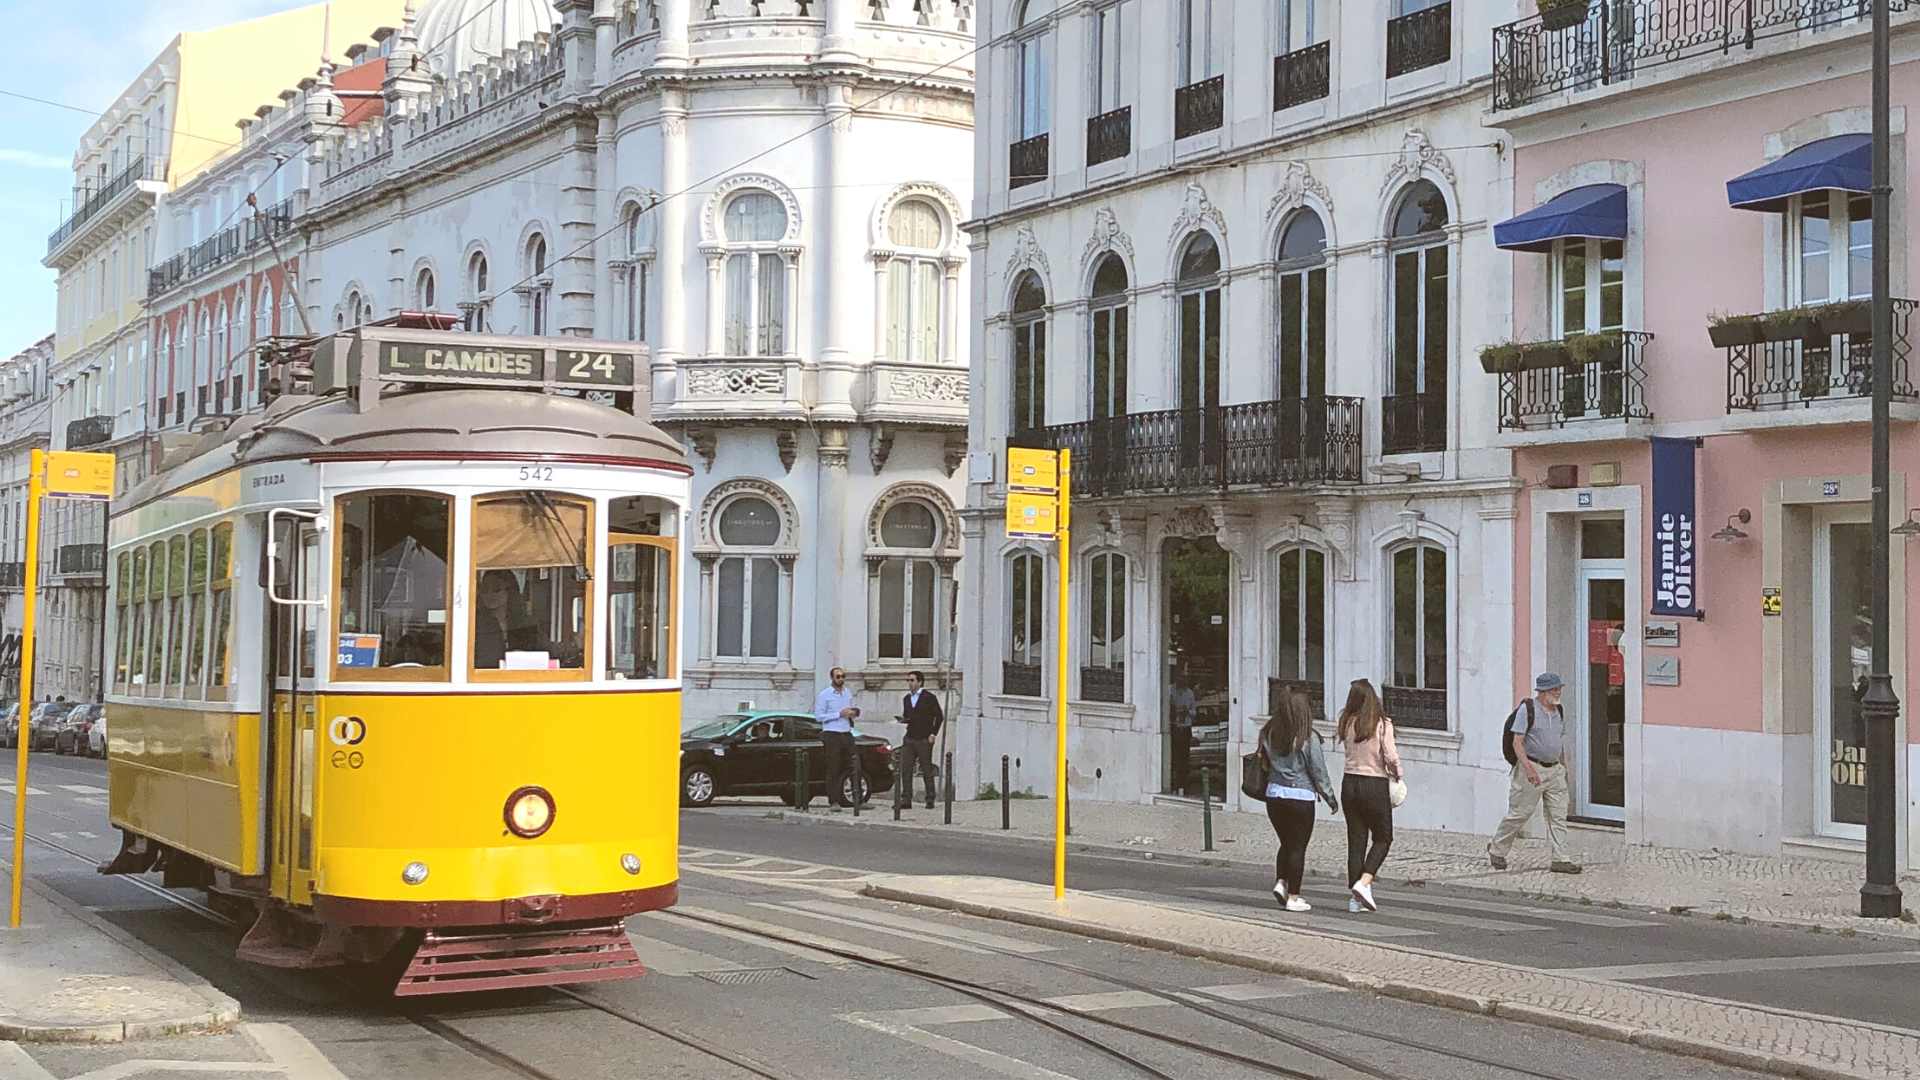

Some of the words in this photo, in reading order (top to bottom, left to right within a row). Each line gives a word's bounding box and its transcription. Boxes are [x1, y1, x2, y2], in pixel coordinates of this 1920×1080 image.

[425, 348, 532, 375] CAMÕES
[569, 352, 615, 378] 24
[520, 466, 553, 481] 542
[1656, 513, 1674, 607] Jamie
[1675, 514, 1692, 608] Oliver
[1832, 762, 1866, 786] Oli
